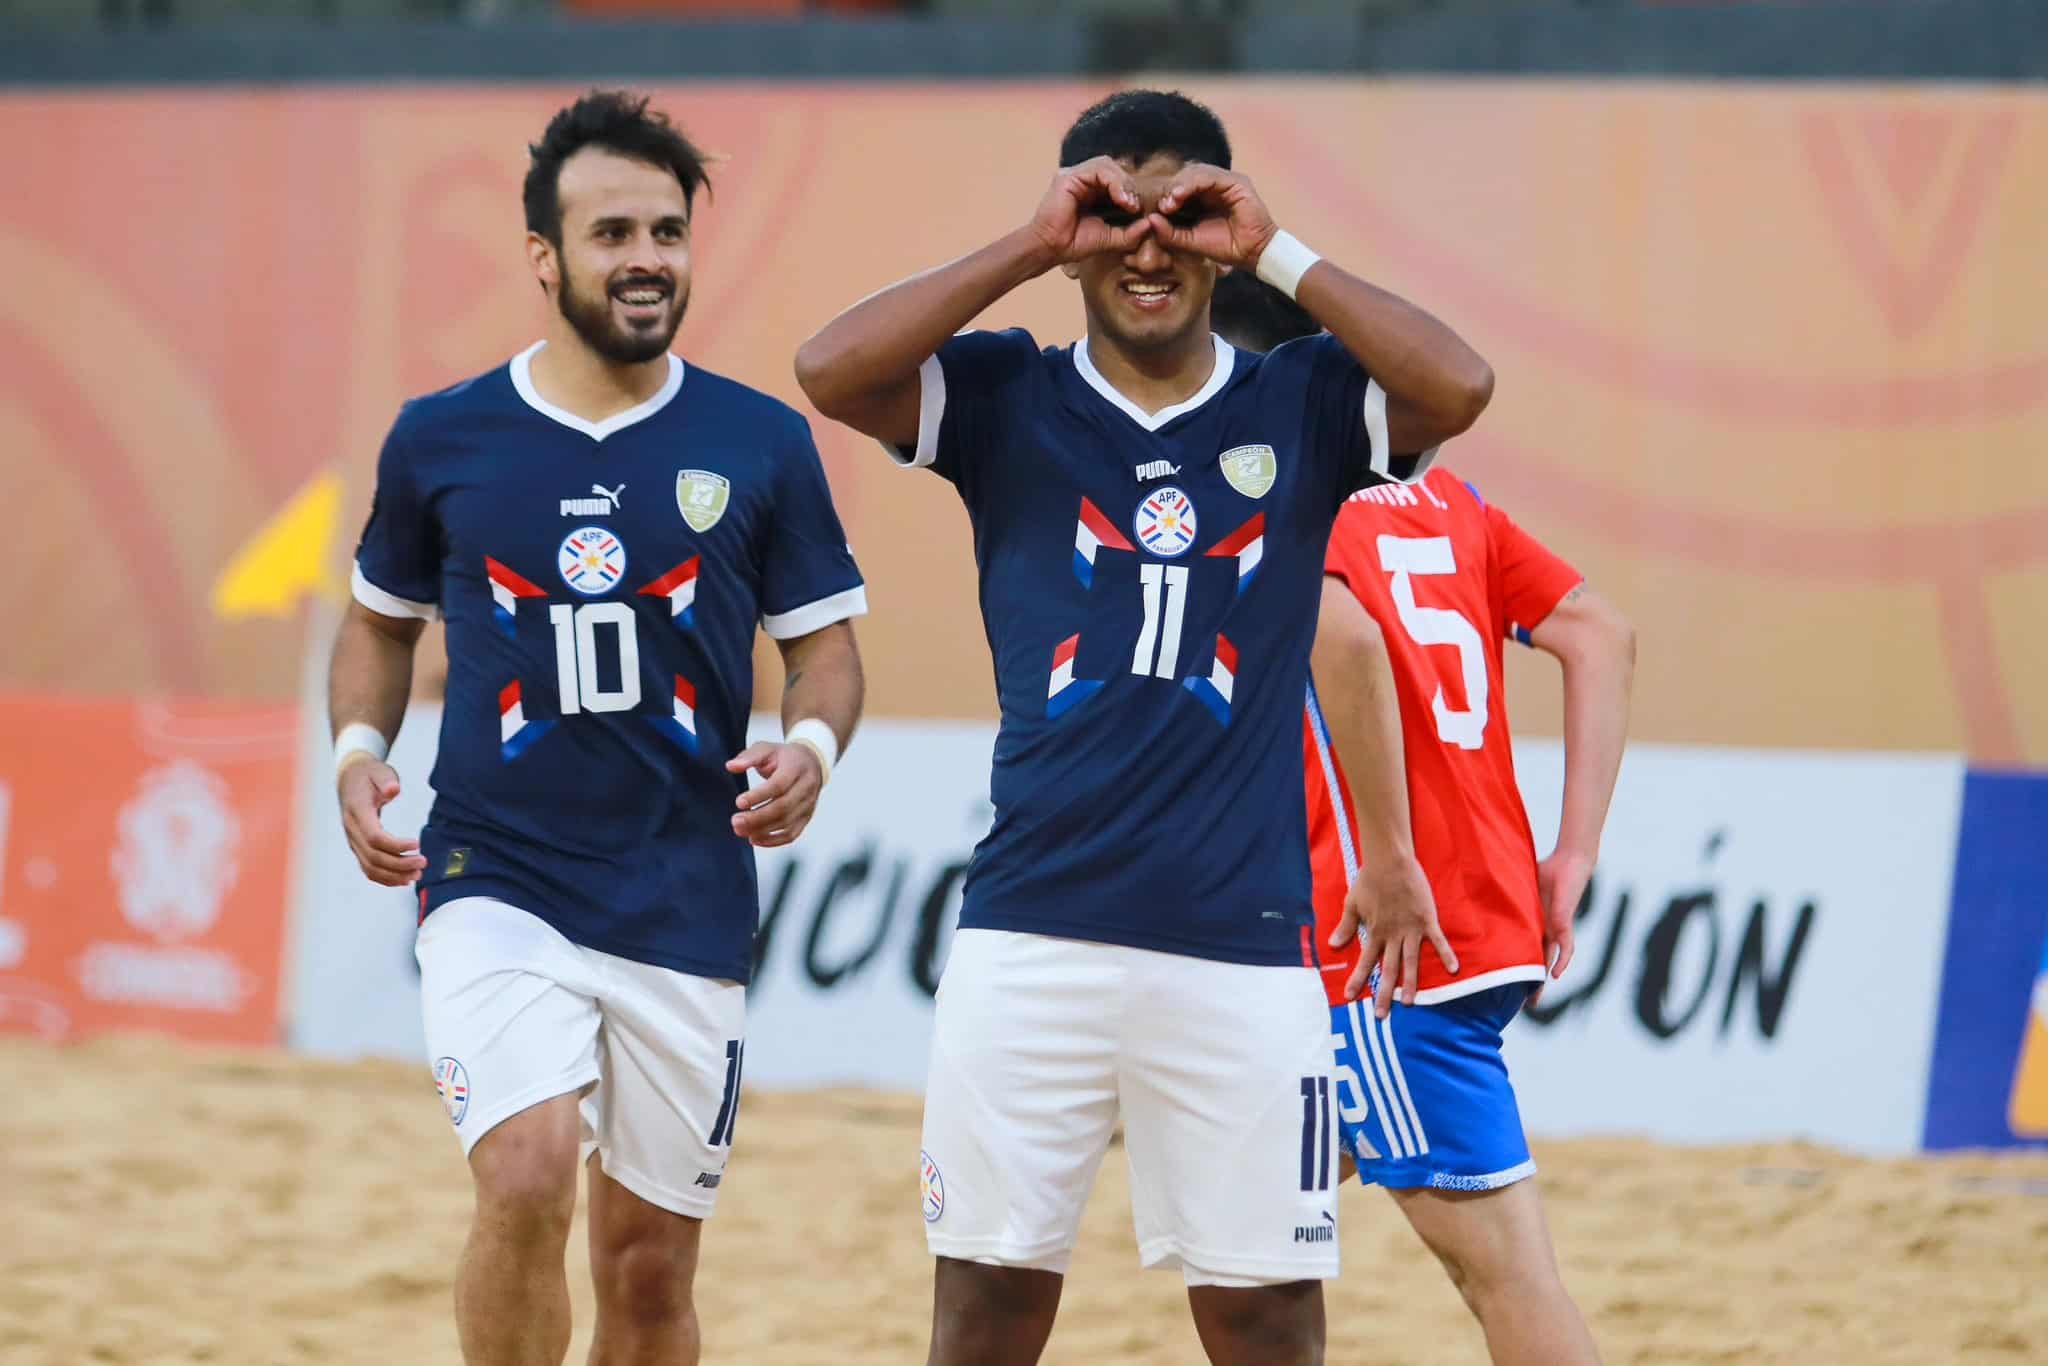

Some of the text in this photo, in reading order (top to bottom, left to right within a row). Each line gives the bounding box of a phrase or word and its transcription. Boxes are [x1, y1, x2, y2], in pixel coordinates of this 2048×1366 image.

[560, 499, 611, 516] PUMA
[1159, 490, 1182, 503] APF
[549, 602, 642, 715] 10
[1132, 563, 1189, 681] 11
[1376, 534, 1488, 750] 5
[1300, 1076, 1330, 1191] 11
[1294, 1225, 1334, 1242] PUMA
